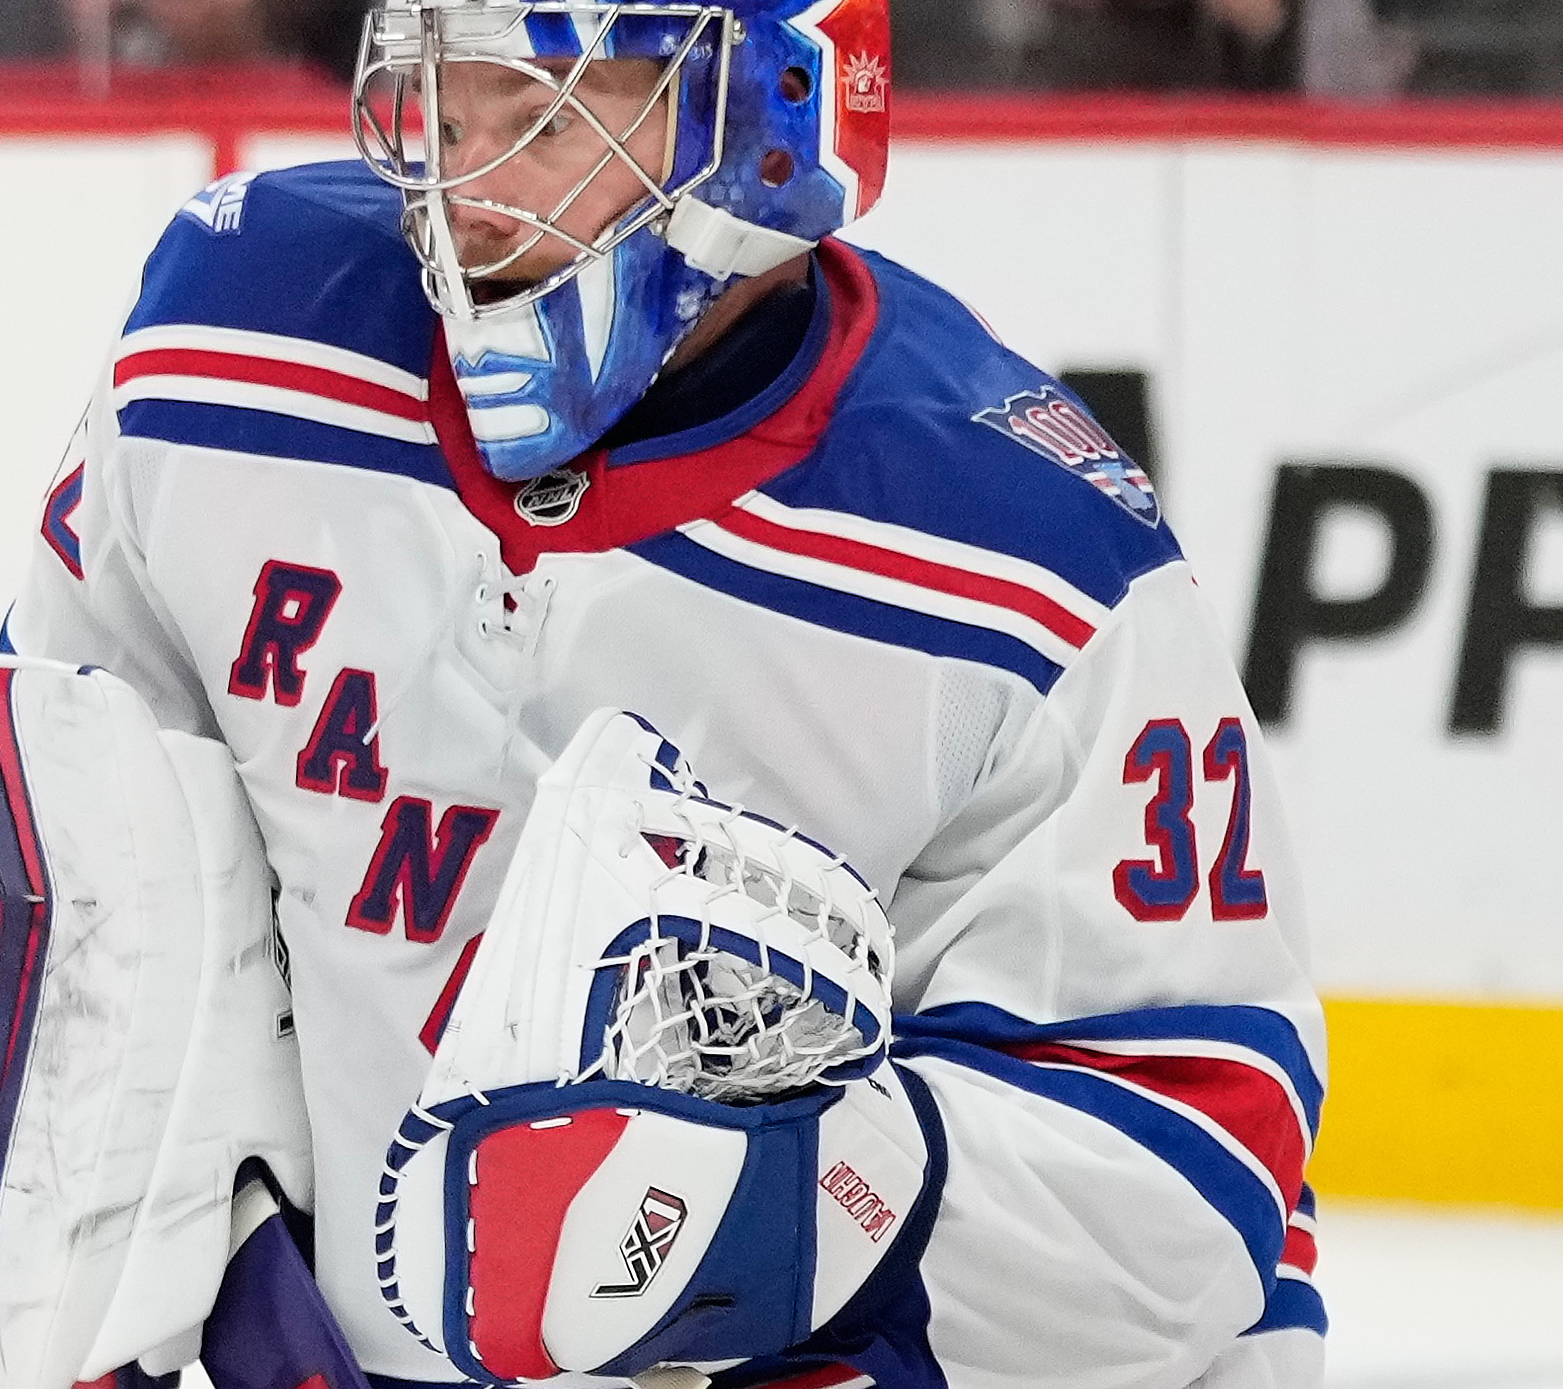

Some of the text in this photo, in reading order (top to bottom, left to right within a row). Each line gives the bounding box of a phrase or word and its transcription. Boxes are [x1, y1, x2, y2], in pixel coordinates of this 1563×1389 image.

[1007, 399, 1120, 466] 100
[1112, 716, 1271, 923] 32
[589, 1186, 689, 1299] VX1
[818, 1160, 897, 1243] VAUGHN
